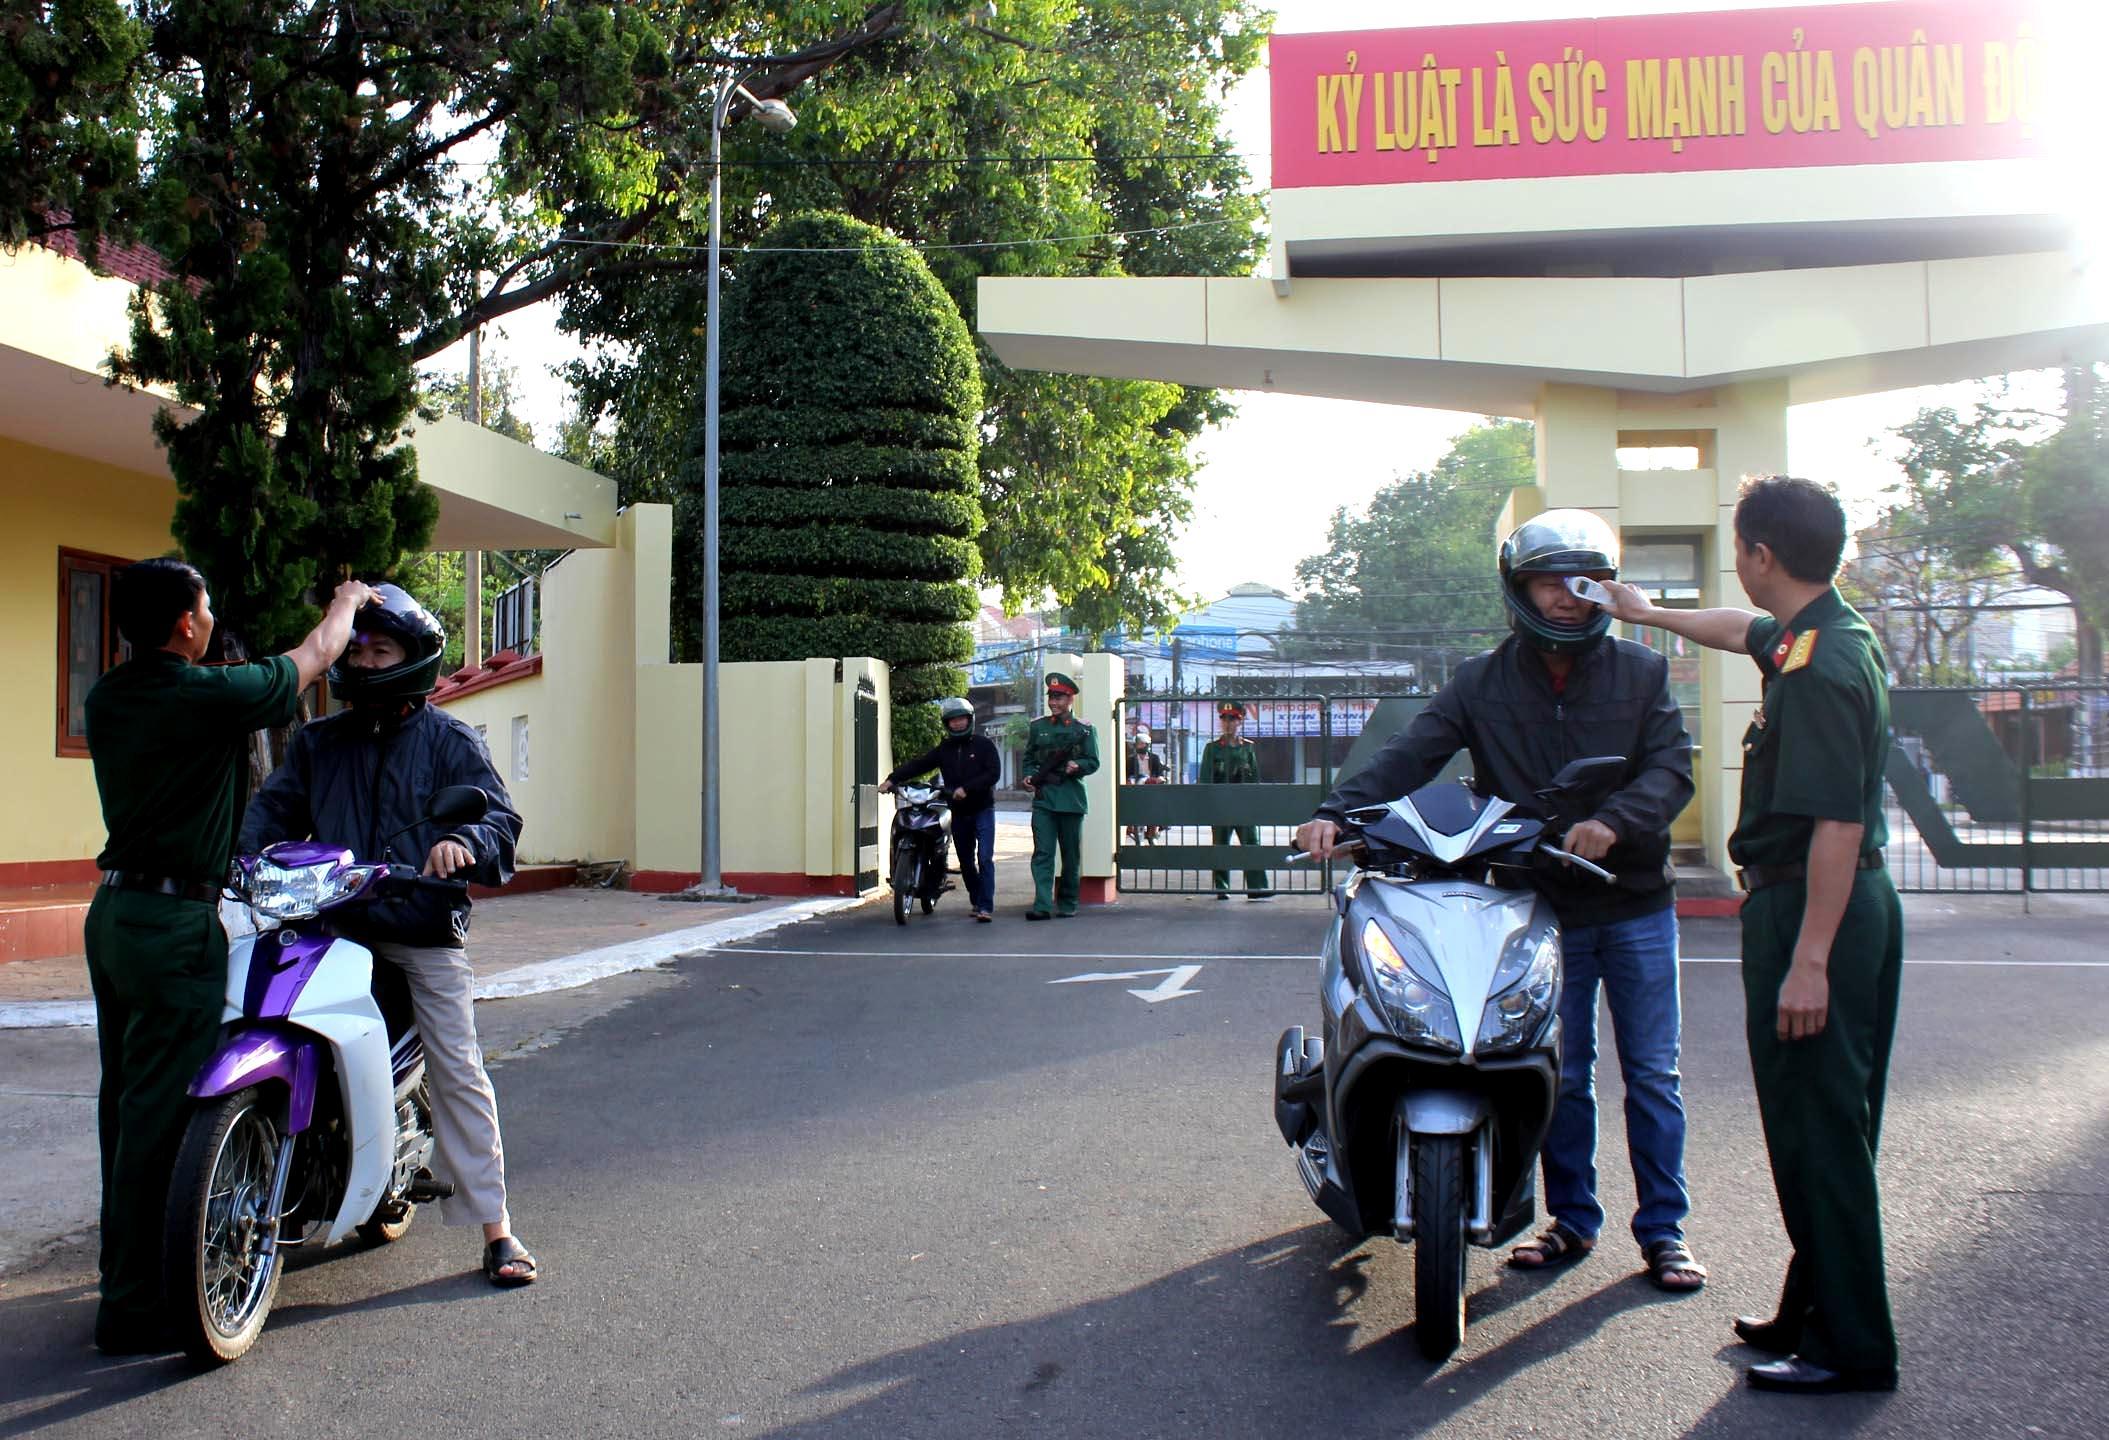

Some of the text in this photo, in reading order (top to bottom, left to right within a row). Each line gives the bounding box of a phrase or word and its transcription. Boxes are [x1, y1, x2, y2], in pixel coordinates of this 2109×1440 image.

[1317, 50, 1364, 153] KỶ
[1374, 53, 1461, 163] LUẬT
[1472, 51, 1520, 147] LÀ
[1528, 47, 1608, 144] SỨC
[1626, 55, 1746, 153] MẠNH
[1761, 27, 1841, 134] CỦA
[1853, 29, 1964, 139] QUÂN
